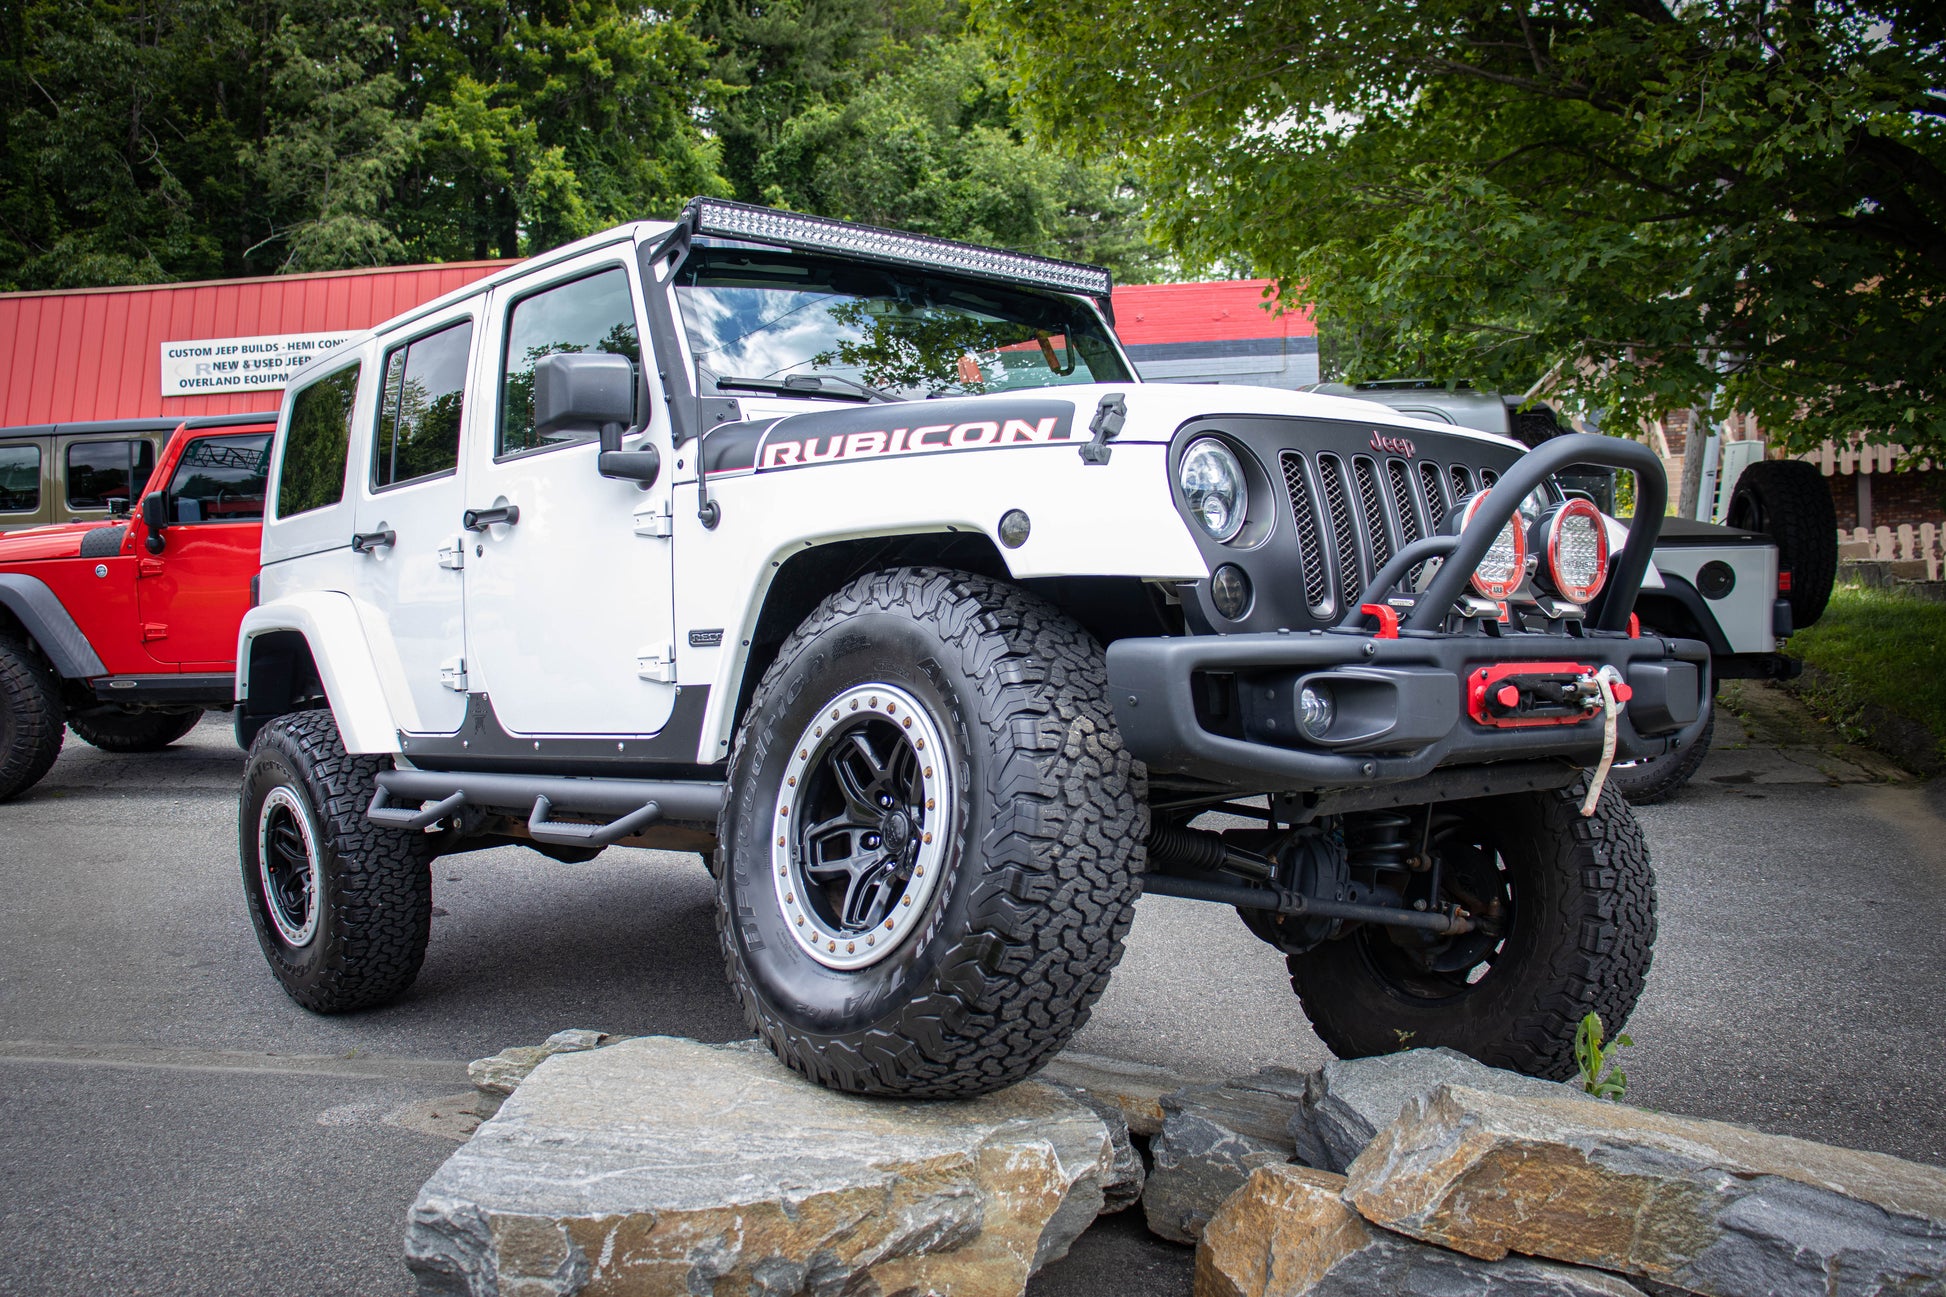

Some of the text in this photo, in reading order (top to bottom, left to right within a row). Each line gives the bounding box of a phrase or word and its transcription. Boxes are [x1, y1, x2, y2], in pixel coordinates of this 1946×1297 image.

[168, 348, 212, 358] CUSTOM
[215, 346, 239, 355] JEEP
[241, 343, 279, 353] BUILDS
[287, 340, 315, 350] HEMI
[212, 360, 239, 370] NEW
[242, 360, 251, 369] &
[253, 358, 283, 368] USED
[179, 376, 241, 388] OVERLAND
[763, 416, 1058, 467] RUBICON
[1369, 430, 1416, 459] Jeep
